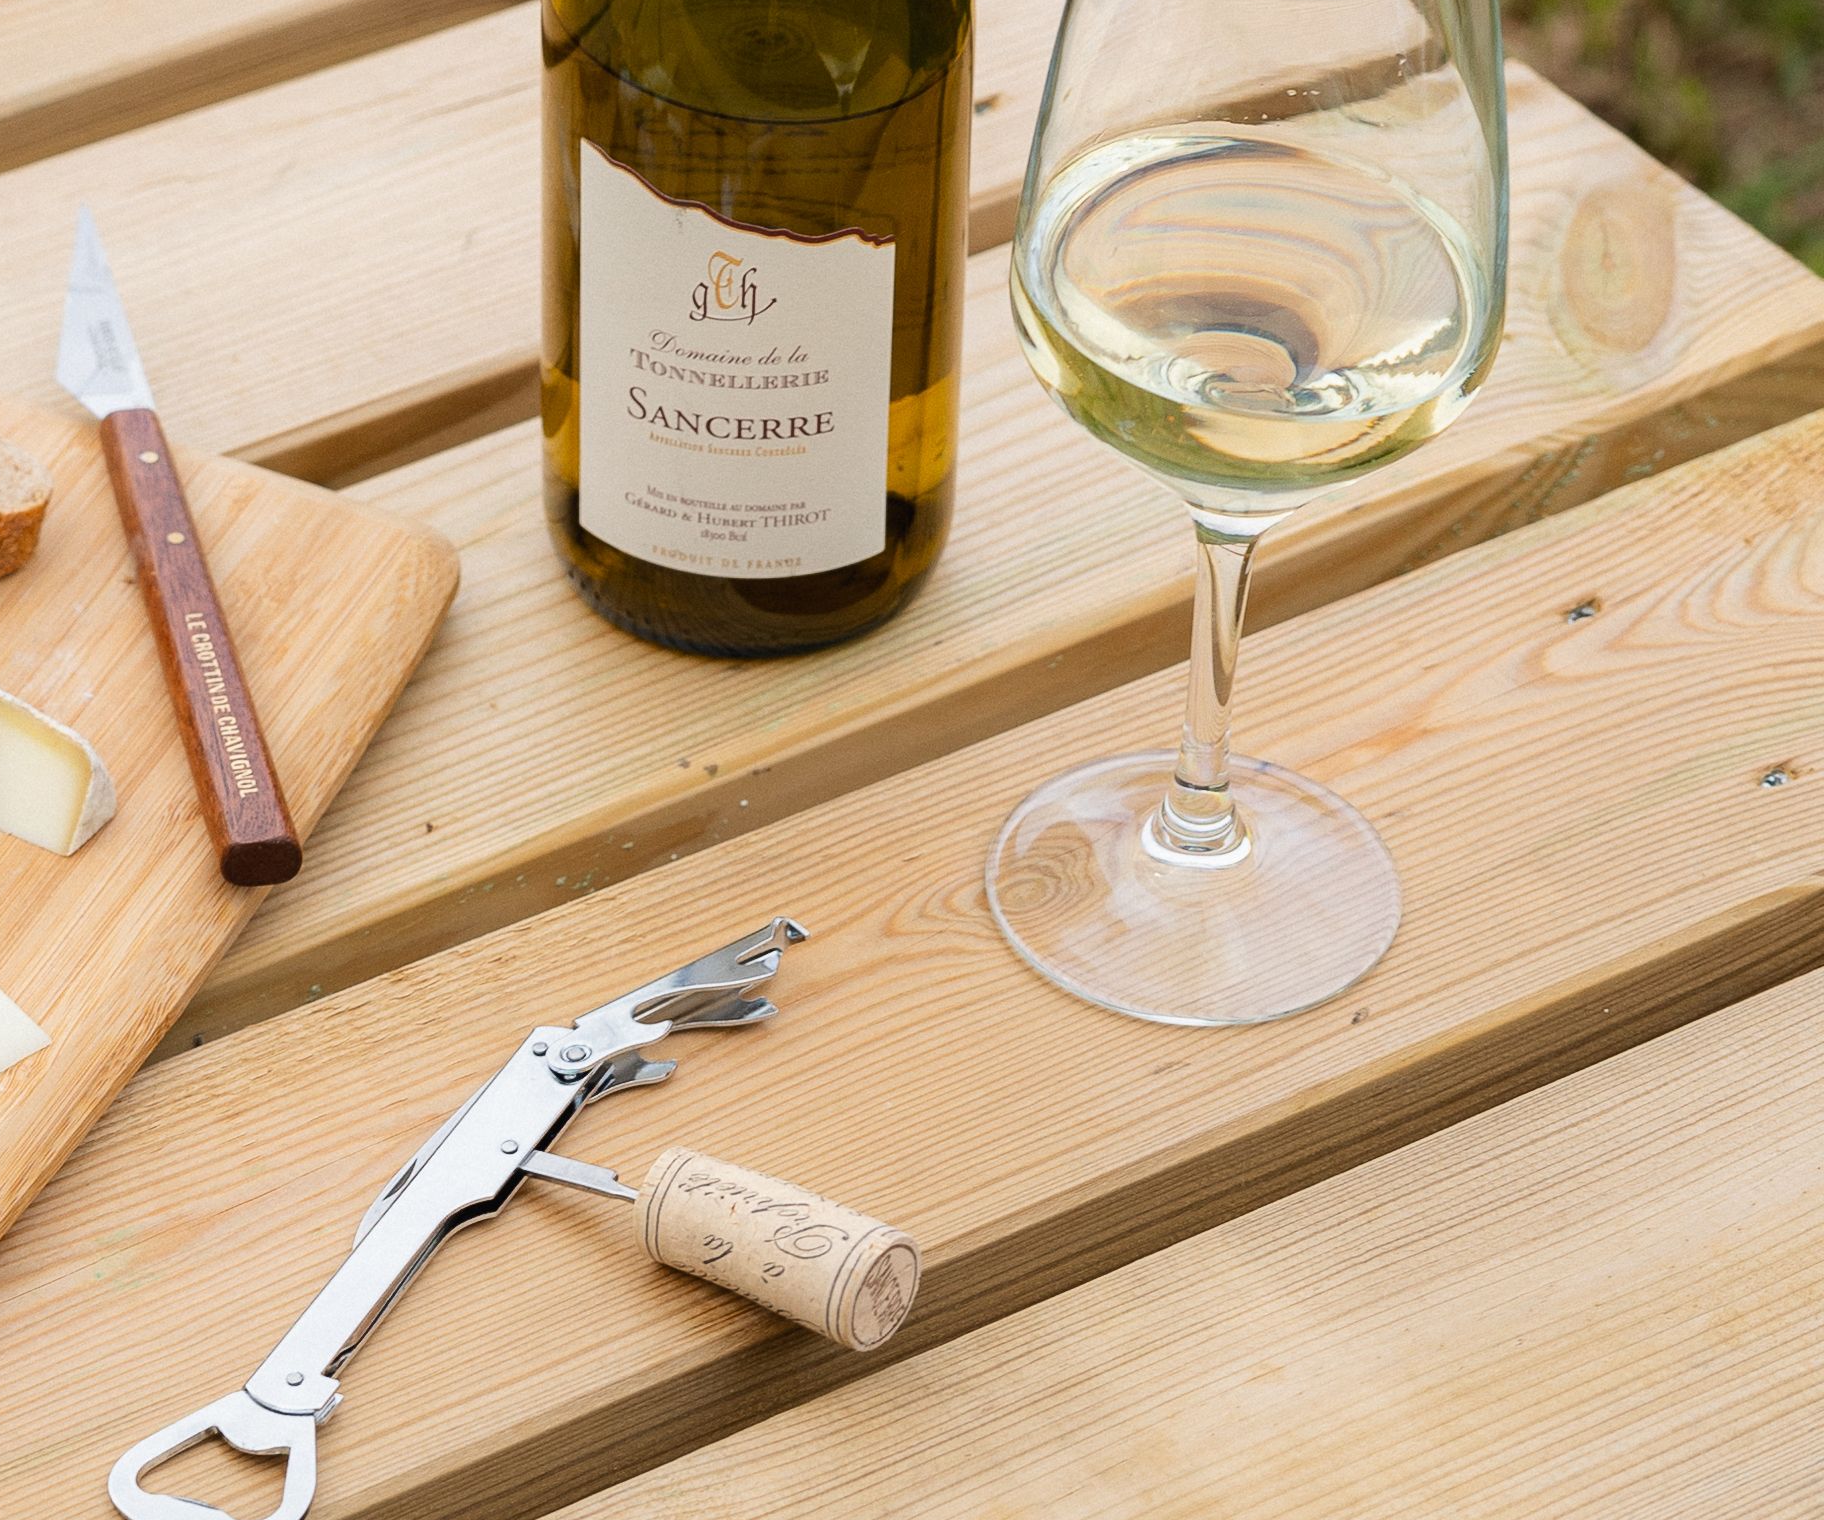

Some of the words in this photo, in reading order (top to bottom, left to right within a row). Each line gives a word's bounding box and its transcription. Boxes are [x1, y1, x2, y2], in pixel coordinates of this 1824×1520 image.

[649, 329, 752, 366] Domaine
[757, 346, 782, 366] de
[787, 345, 809, 364] la
[629, 348, 830, 390] TONNELLERIE
[627, 386, 835, 440] SANCERRE
[624, 491, 678, 518] GÉRARD
[681, 513, 693, 523] &
[697, 511, 757, 529] HUBERT
[759, 508, 832, 529] THIROT
[680, 497, 726, 511] BOUTEILLE
[729, 503, 743, 512] AU
[745, 503, 787, 513] DOMAINE
[790, 501, 807, 511] PAR
[720, 558, 739, 569] DE
[185, 612, 207, 631] LE
[191, 632, 227, 695] CROTTIN
[210, 695, 231, 715] DE
[217, 716, 260, 799] CHAVIGNOL
[702, 1233, 735, 1265] la
